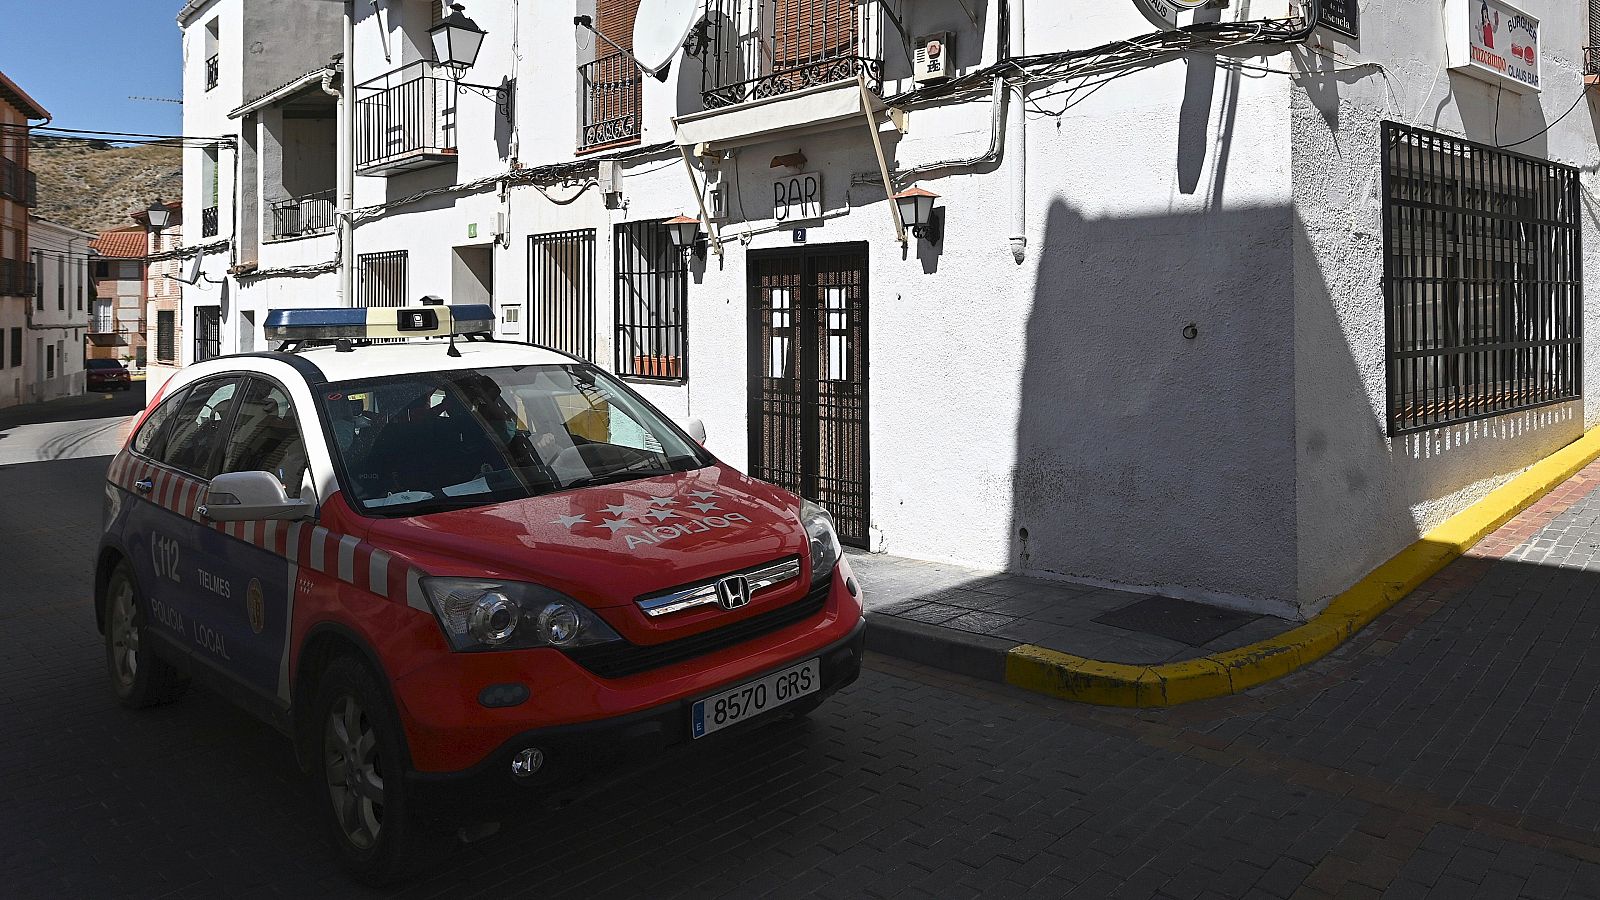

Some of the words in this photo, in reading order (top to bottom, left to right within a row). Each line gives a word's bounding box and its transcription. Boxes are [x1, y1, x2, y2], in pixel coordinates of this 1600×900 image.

[1150, 0, 1167, 17] AUS
[1322, 8, 1351, 29] Escuela
[1507, 15, 1537, 45] BURGUER
[1471, 45, 1507, 73] ruzcampo
[1508, 64, 1527, 83] CLAUS
[1528, 72, 1539, 87] BAR
[774, 176, 817, 221] BAR
[797, 230, 802, 240] 2
[158, 535, 181, 583] 112
[198, 567, 231, 599] TIELMES
[151, 598, 186, 637] POLICIA
[193, 619, 231, 661] LOCAL
[714, 684, 767, 725] 8570
[776, 666, 812, 701] GRS
[696, 722, 704, 732] E
